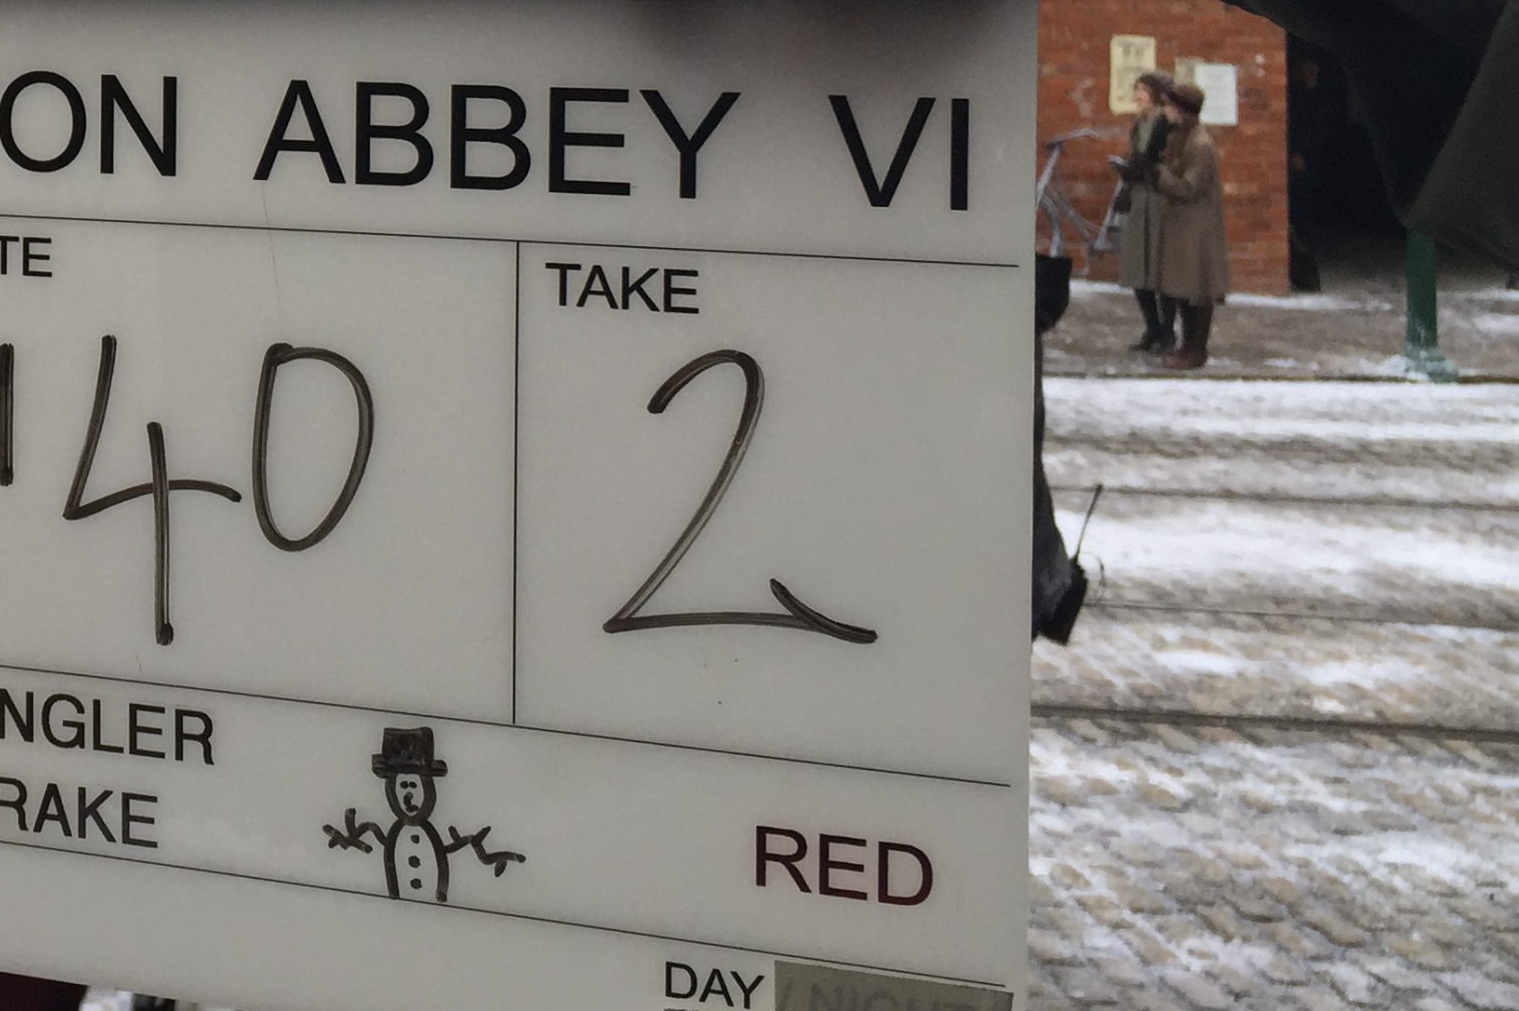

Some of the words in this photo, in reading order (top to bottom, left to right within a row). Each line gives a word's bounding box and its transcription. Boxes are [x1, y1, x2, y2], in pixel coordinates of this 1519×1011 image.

[253, 80, 742, 199] ABBEY
[827, 94, 970, 211] VI
[545, 262, 700, 315] TAKE
[602, 349, 879, 644] 2
[755, 825, 934, 906] RED
[665, 961, 764, 1010] DAY
